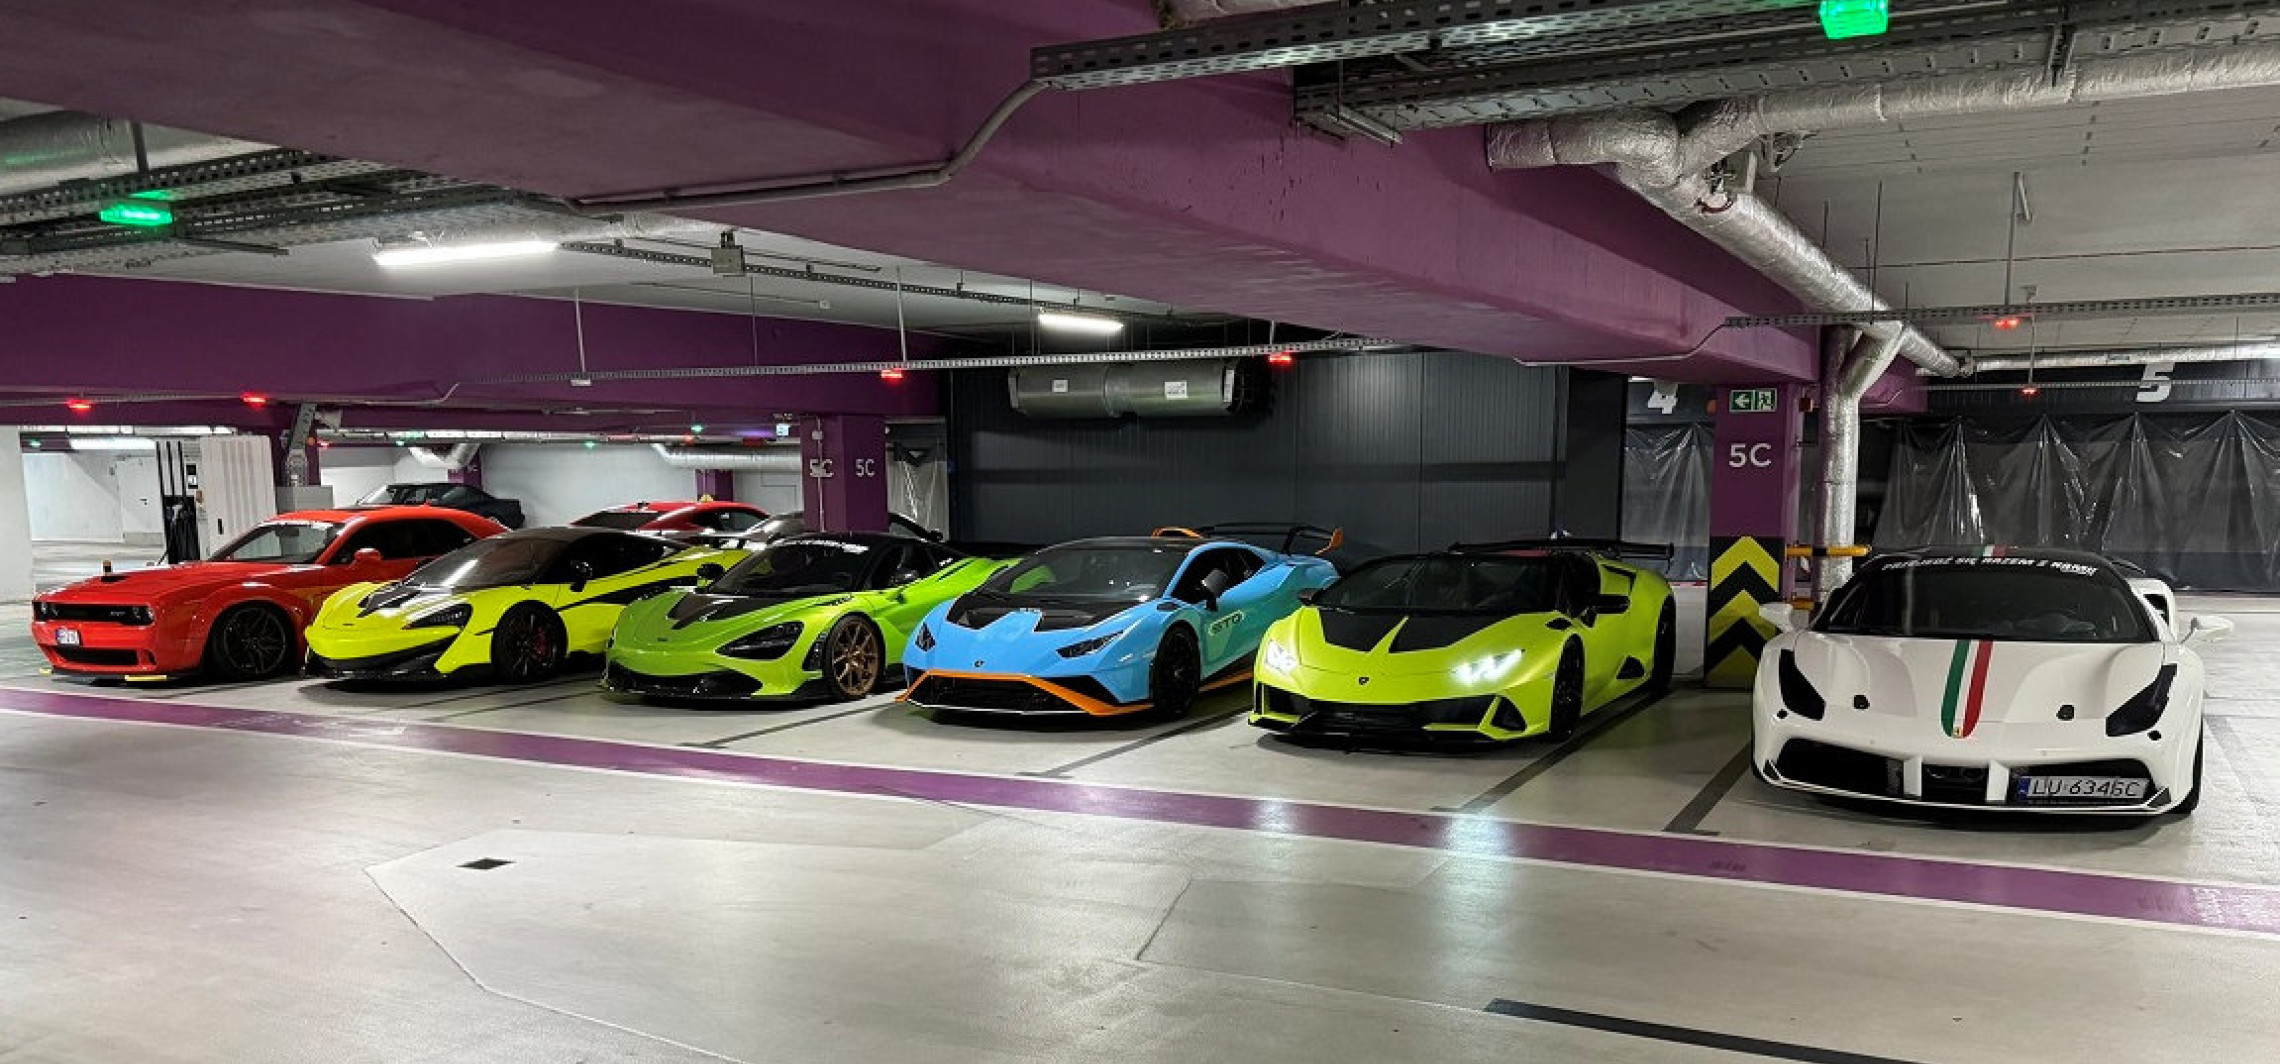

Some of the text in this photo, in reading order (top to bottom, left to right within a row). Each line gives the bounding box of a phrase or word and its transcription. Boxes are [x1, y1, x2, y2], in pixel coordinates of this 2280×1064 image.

[2136, 362, 2175, 402] 5
[1647, 381, 1679, 414] 4
[855, 458, 875, 478] 5C
[1728, 443, 1772, 468] 5C
[2033, 779, 2063, 795] LU
